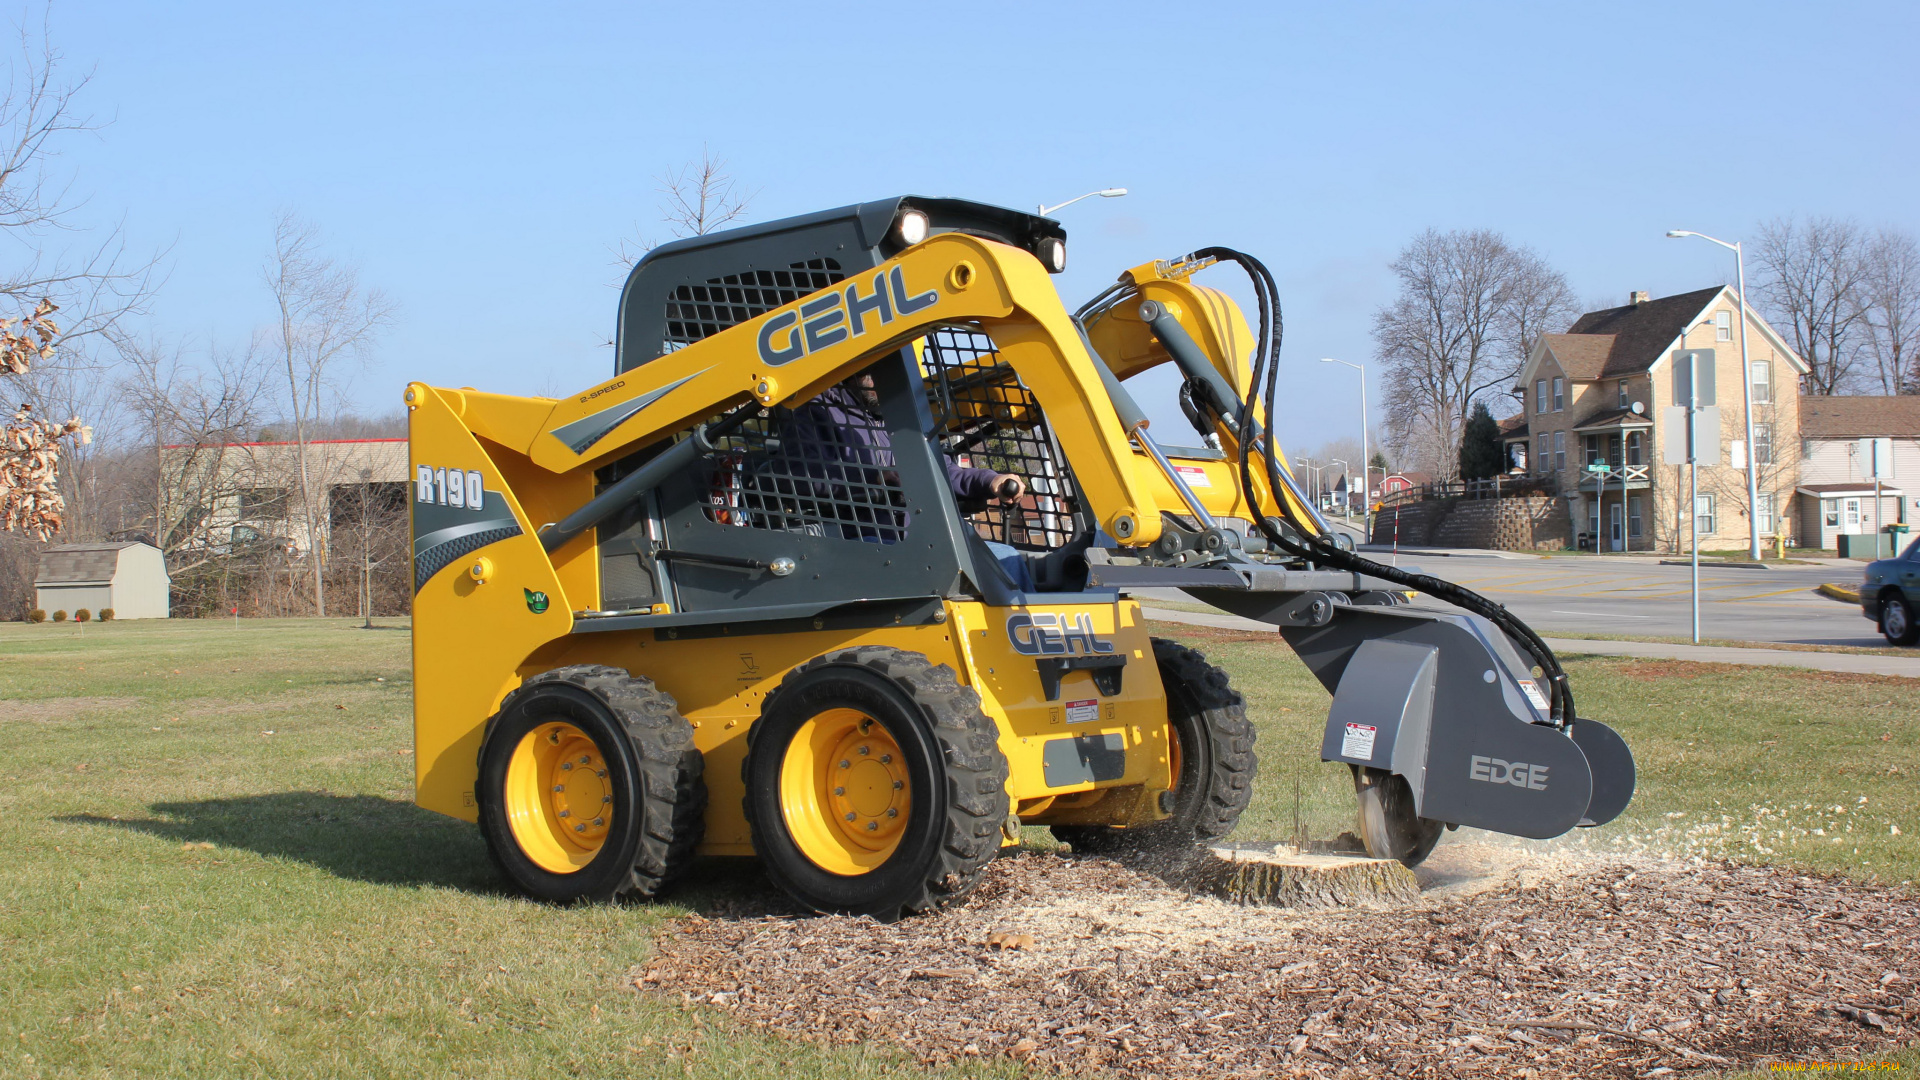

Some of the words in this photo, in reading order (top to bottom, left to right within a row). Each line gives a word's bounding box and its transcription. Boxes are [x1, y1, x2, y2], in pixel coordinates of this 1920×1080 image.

[757, 264, 939, 367] GEHL
[580, 381, 626, 403] 2-SPEED
[417, 464, 484, 511] R190
[1006, 612, 1114, 655] GEHL
[1470, 755, 1550, 791] EDGE
